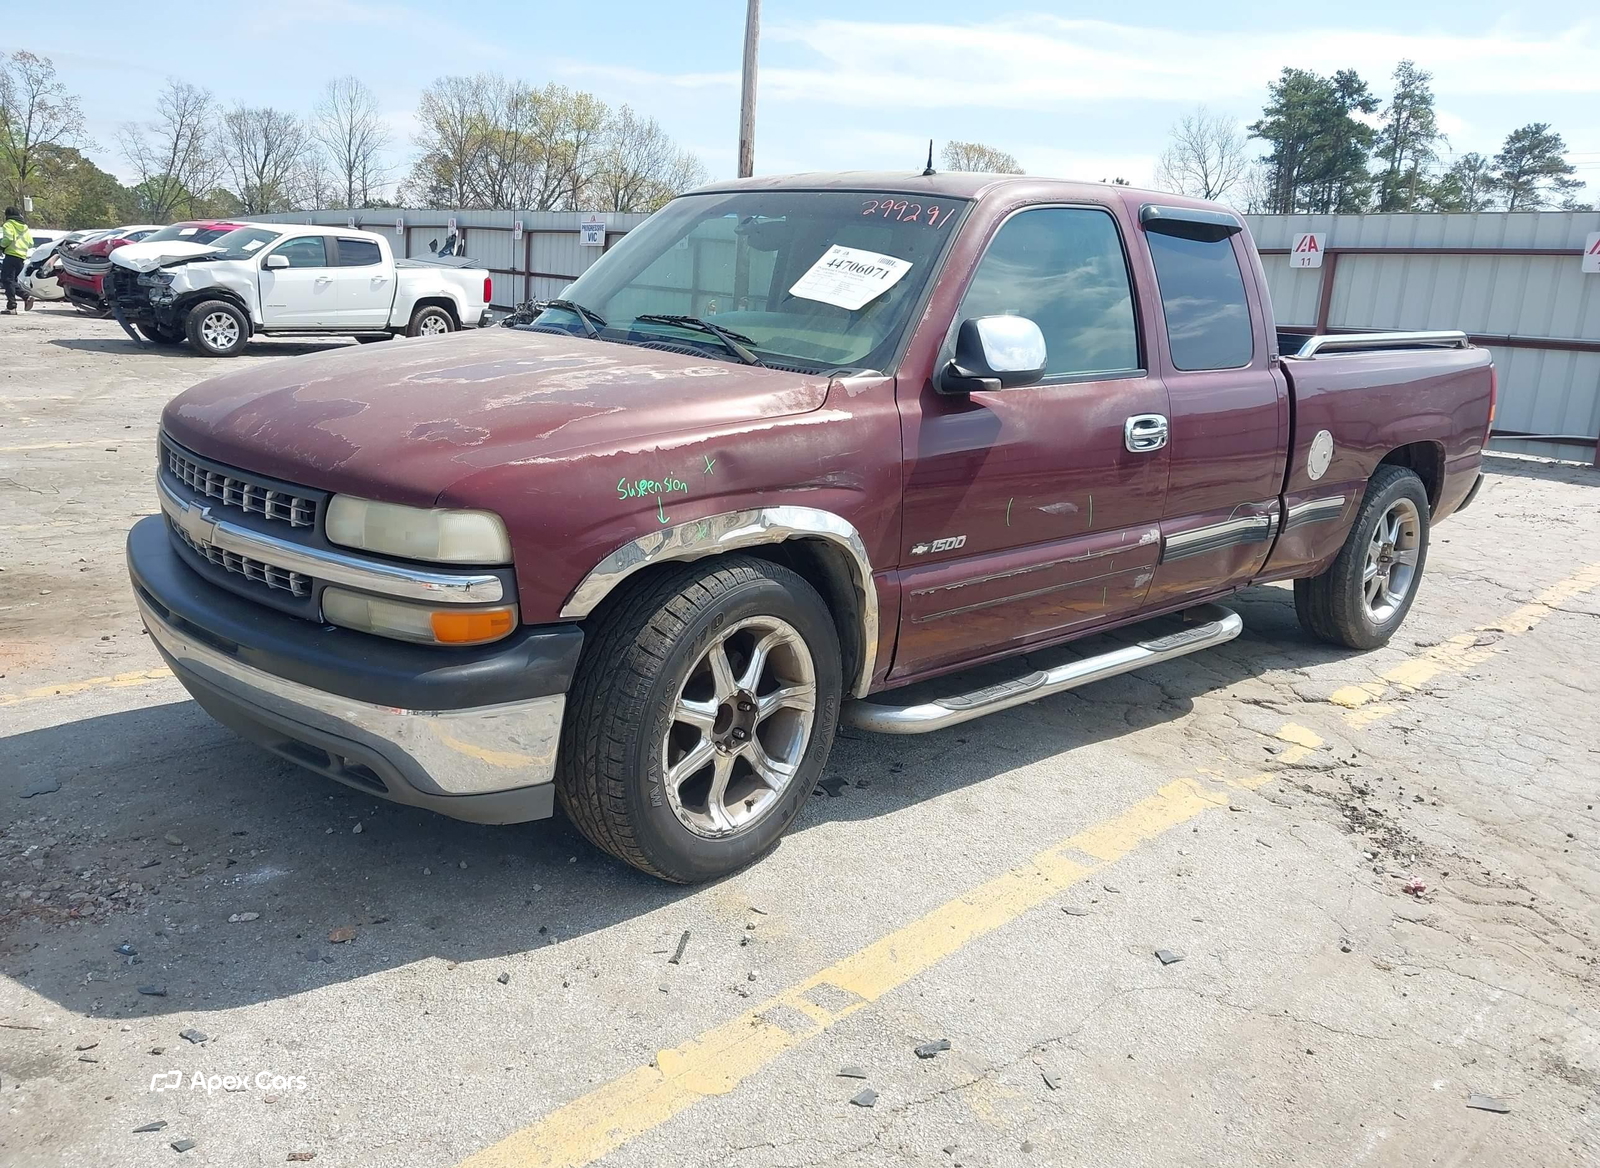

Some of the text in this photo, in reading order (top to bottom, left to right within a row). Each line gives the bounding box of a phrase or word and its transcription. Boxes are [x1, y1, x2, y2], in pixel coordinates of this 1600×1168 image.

[861, 198, 956, 230] 299291
[587, 232, 598, 242] VIC
[826, 258, 890, 280] 44706071
[1300, 257, 1311, 267] 11
[930, 534, 967, 553] 1500
[813, 677, 837, 763] RAVO
[646, 678, 677, 807] MAXXIS
